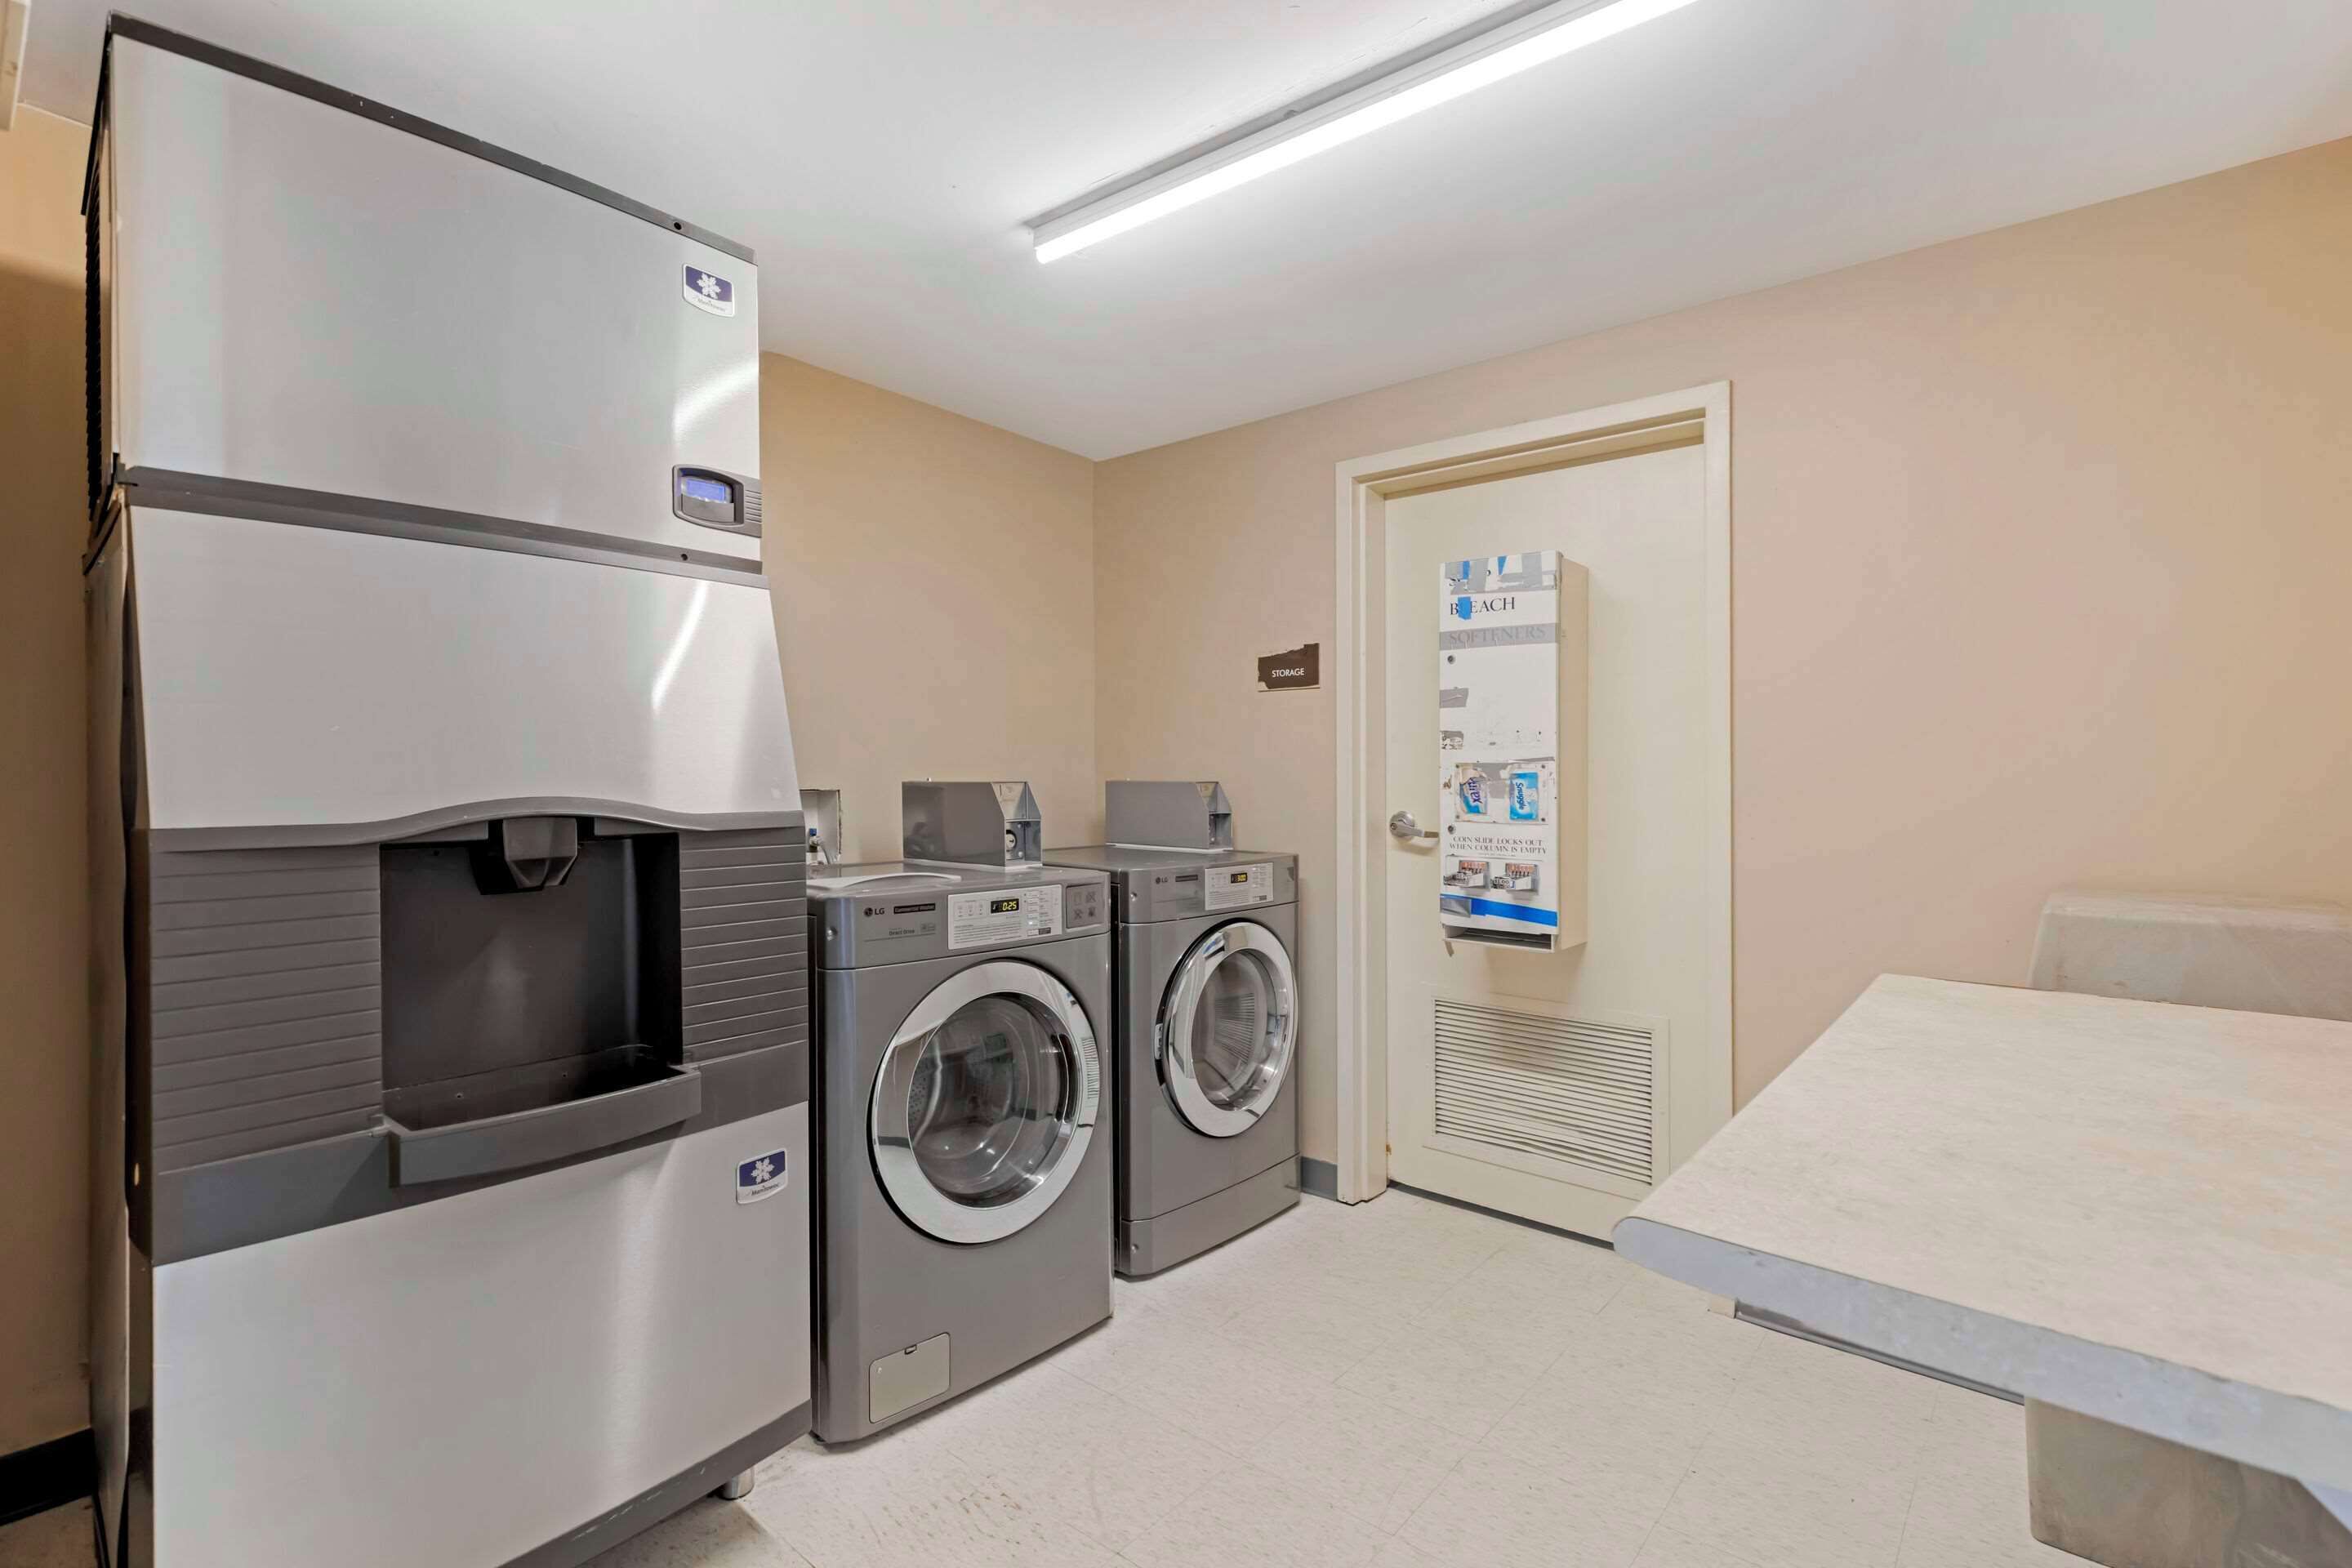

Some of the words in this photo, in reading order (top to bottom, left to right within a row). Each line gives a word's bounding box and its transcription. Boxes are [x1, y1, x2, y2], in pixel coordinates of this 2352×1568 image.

[1450, 597, 1515, 615] BEACH
[1272, 668, 1305, 678] STORAGE
[1468, 778, 1483, 804] urex
[1516, 782, 1527, 810] Snuggle
[1453, 835, 1472, 844] COIN
[1474, 836, 1494, 844] SLIDE
[1496, 837, 1523, 845] LOCKS
[1474, 844, 1509, 852] COLUMN
[1520, 847, 1548, 855] EMPTY
